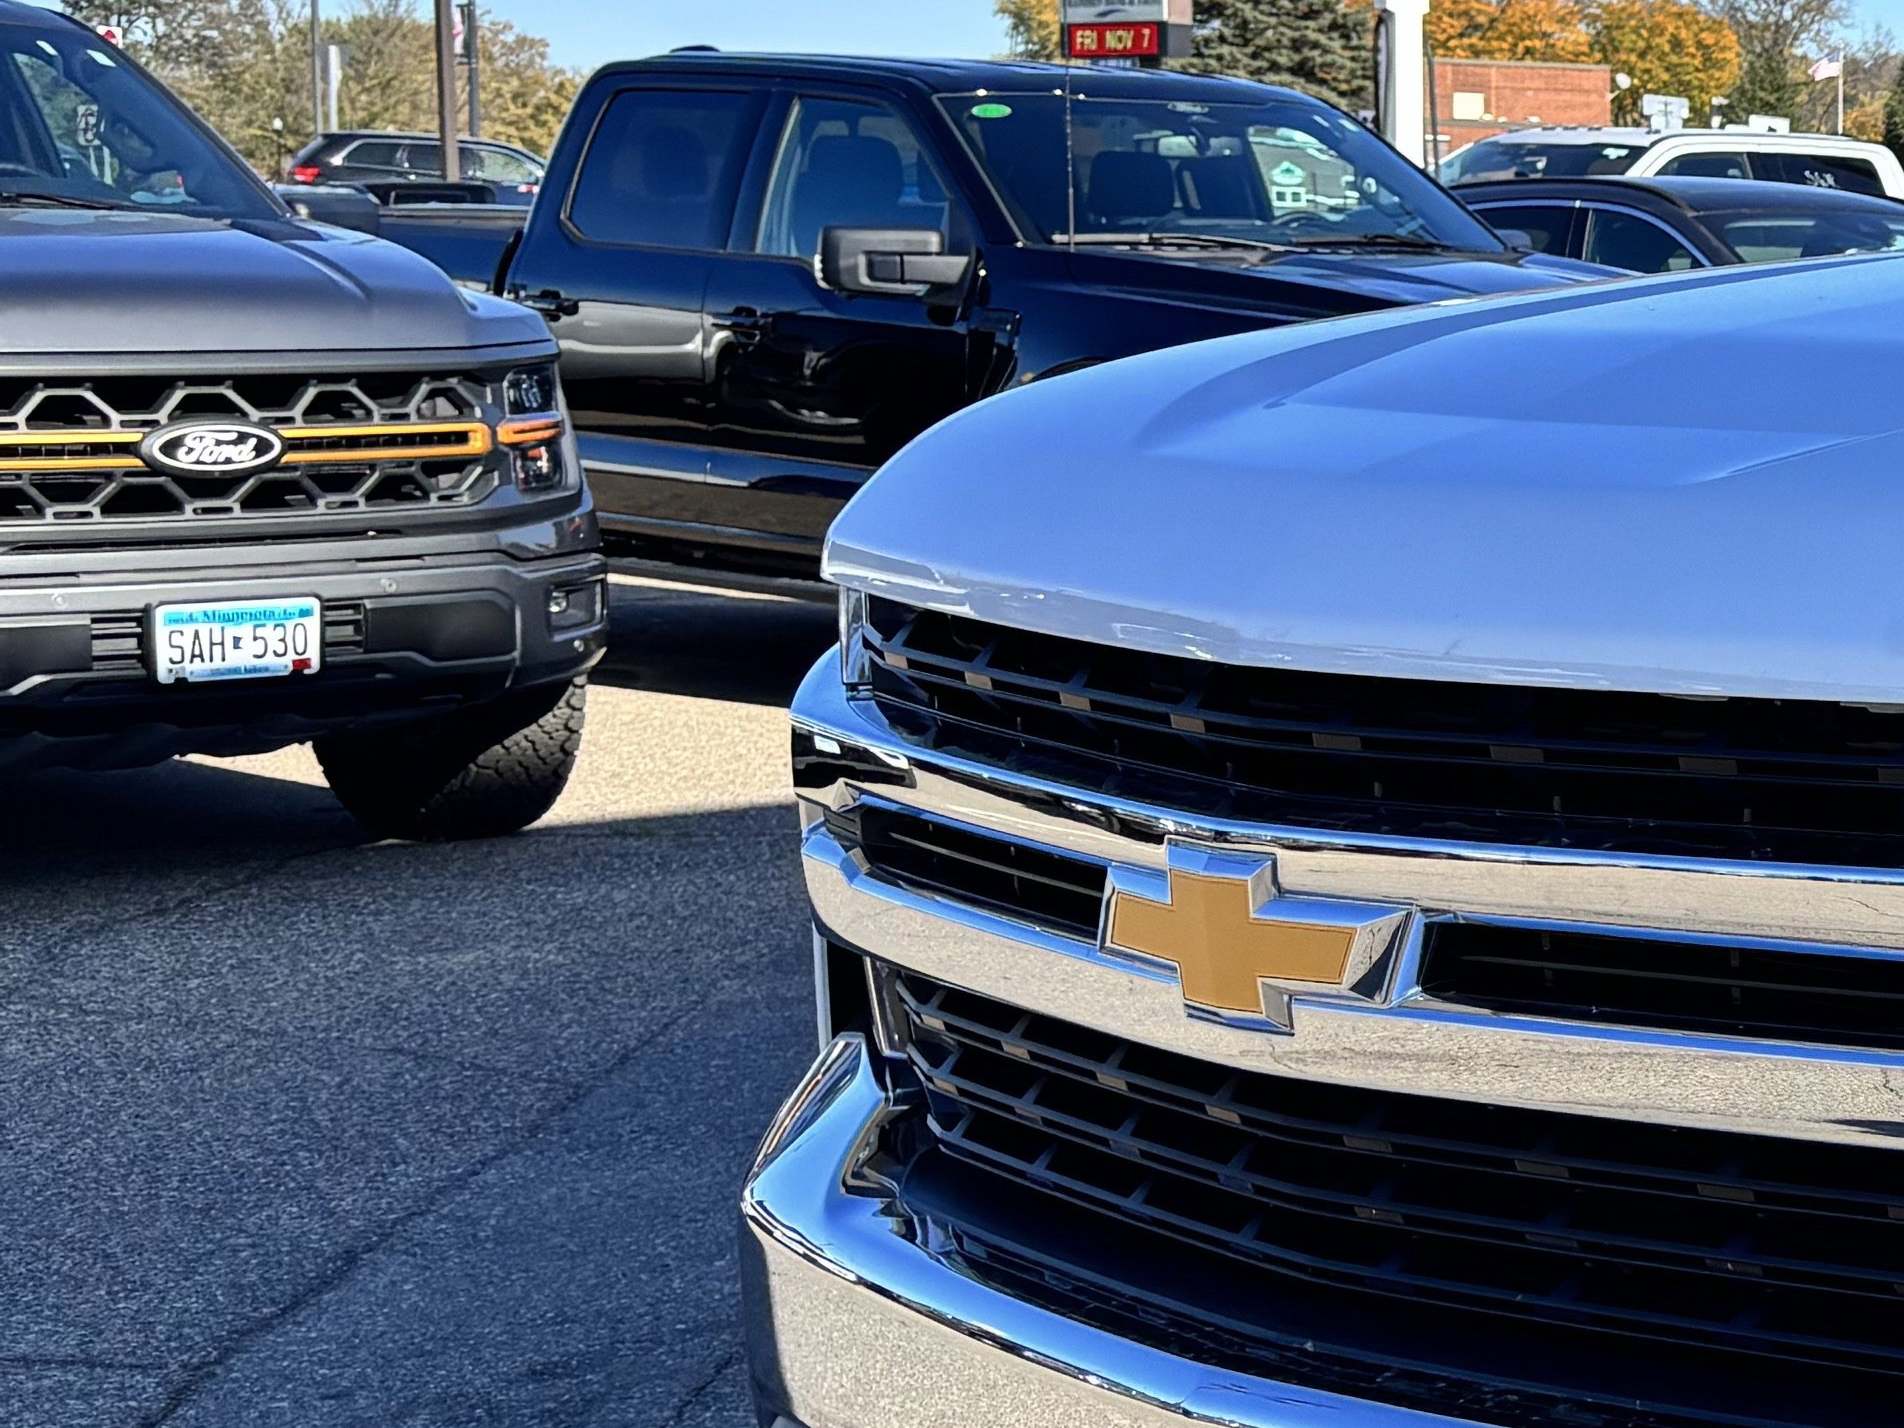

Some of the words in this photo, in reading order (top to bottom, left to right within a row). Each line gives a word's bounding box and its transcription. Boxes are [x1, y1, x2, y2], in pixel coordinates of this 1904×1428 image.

[1076, 29, 1097, 50] FRI
[1105, 29, 1134, 50] NOV
[1141, 28, 1151, 48] 7
[177, 431, 258, 463] Ford
[168, 625, 226, 664] SAH
[252, 623, 308, 659] 530
